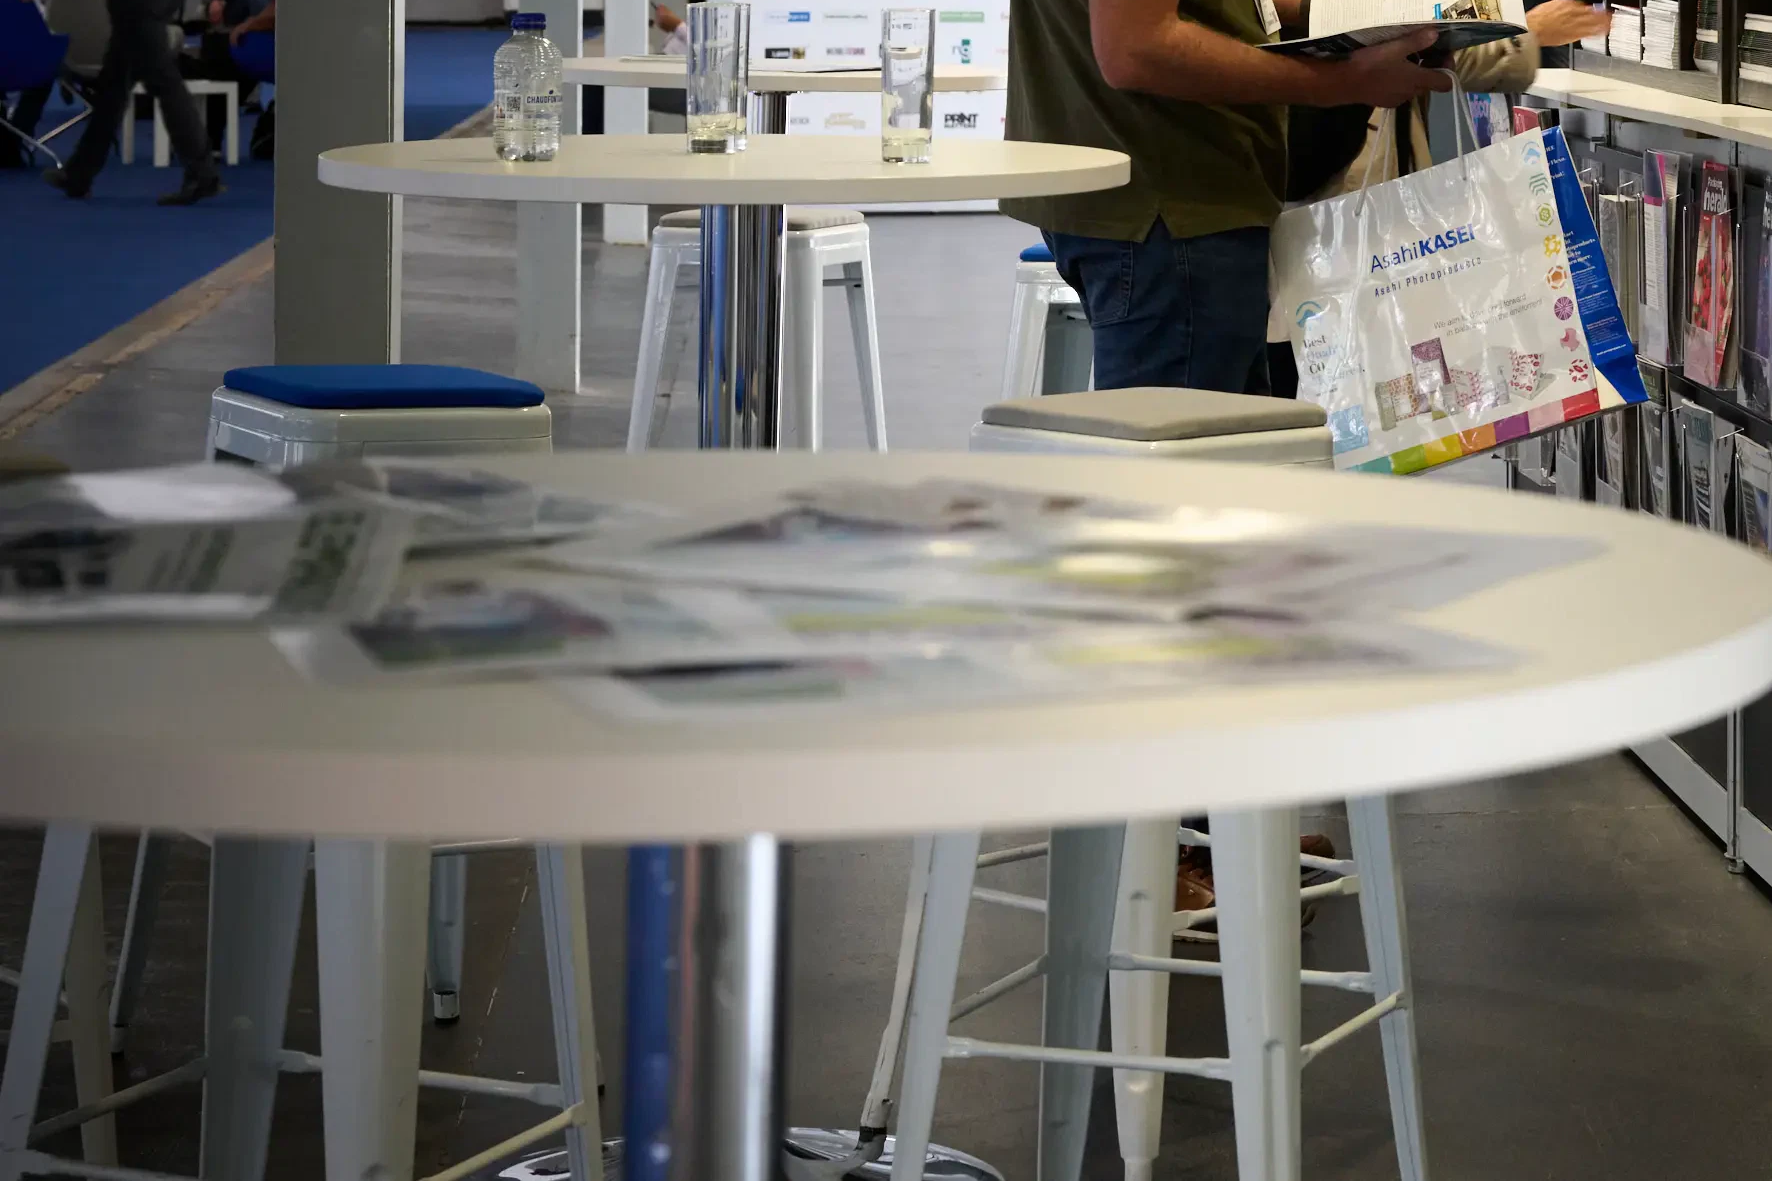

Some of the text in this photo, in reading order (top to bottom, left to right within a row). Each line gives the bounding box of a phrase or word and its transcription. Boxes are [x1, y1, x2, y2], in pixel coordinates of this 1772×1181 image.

[943, 112, 979, 124] PRINT
[1703, 187, 1728, 214] herald
[1374, 256, 1482, 298] Asahi Photoproducts
[1498, 311, 1509, 320] the
[1433, 320, 1446, 330] We
